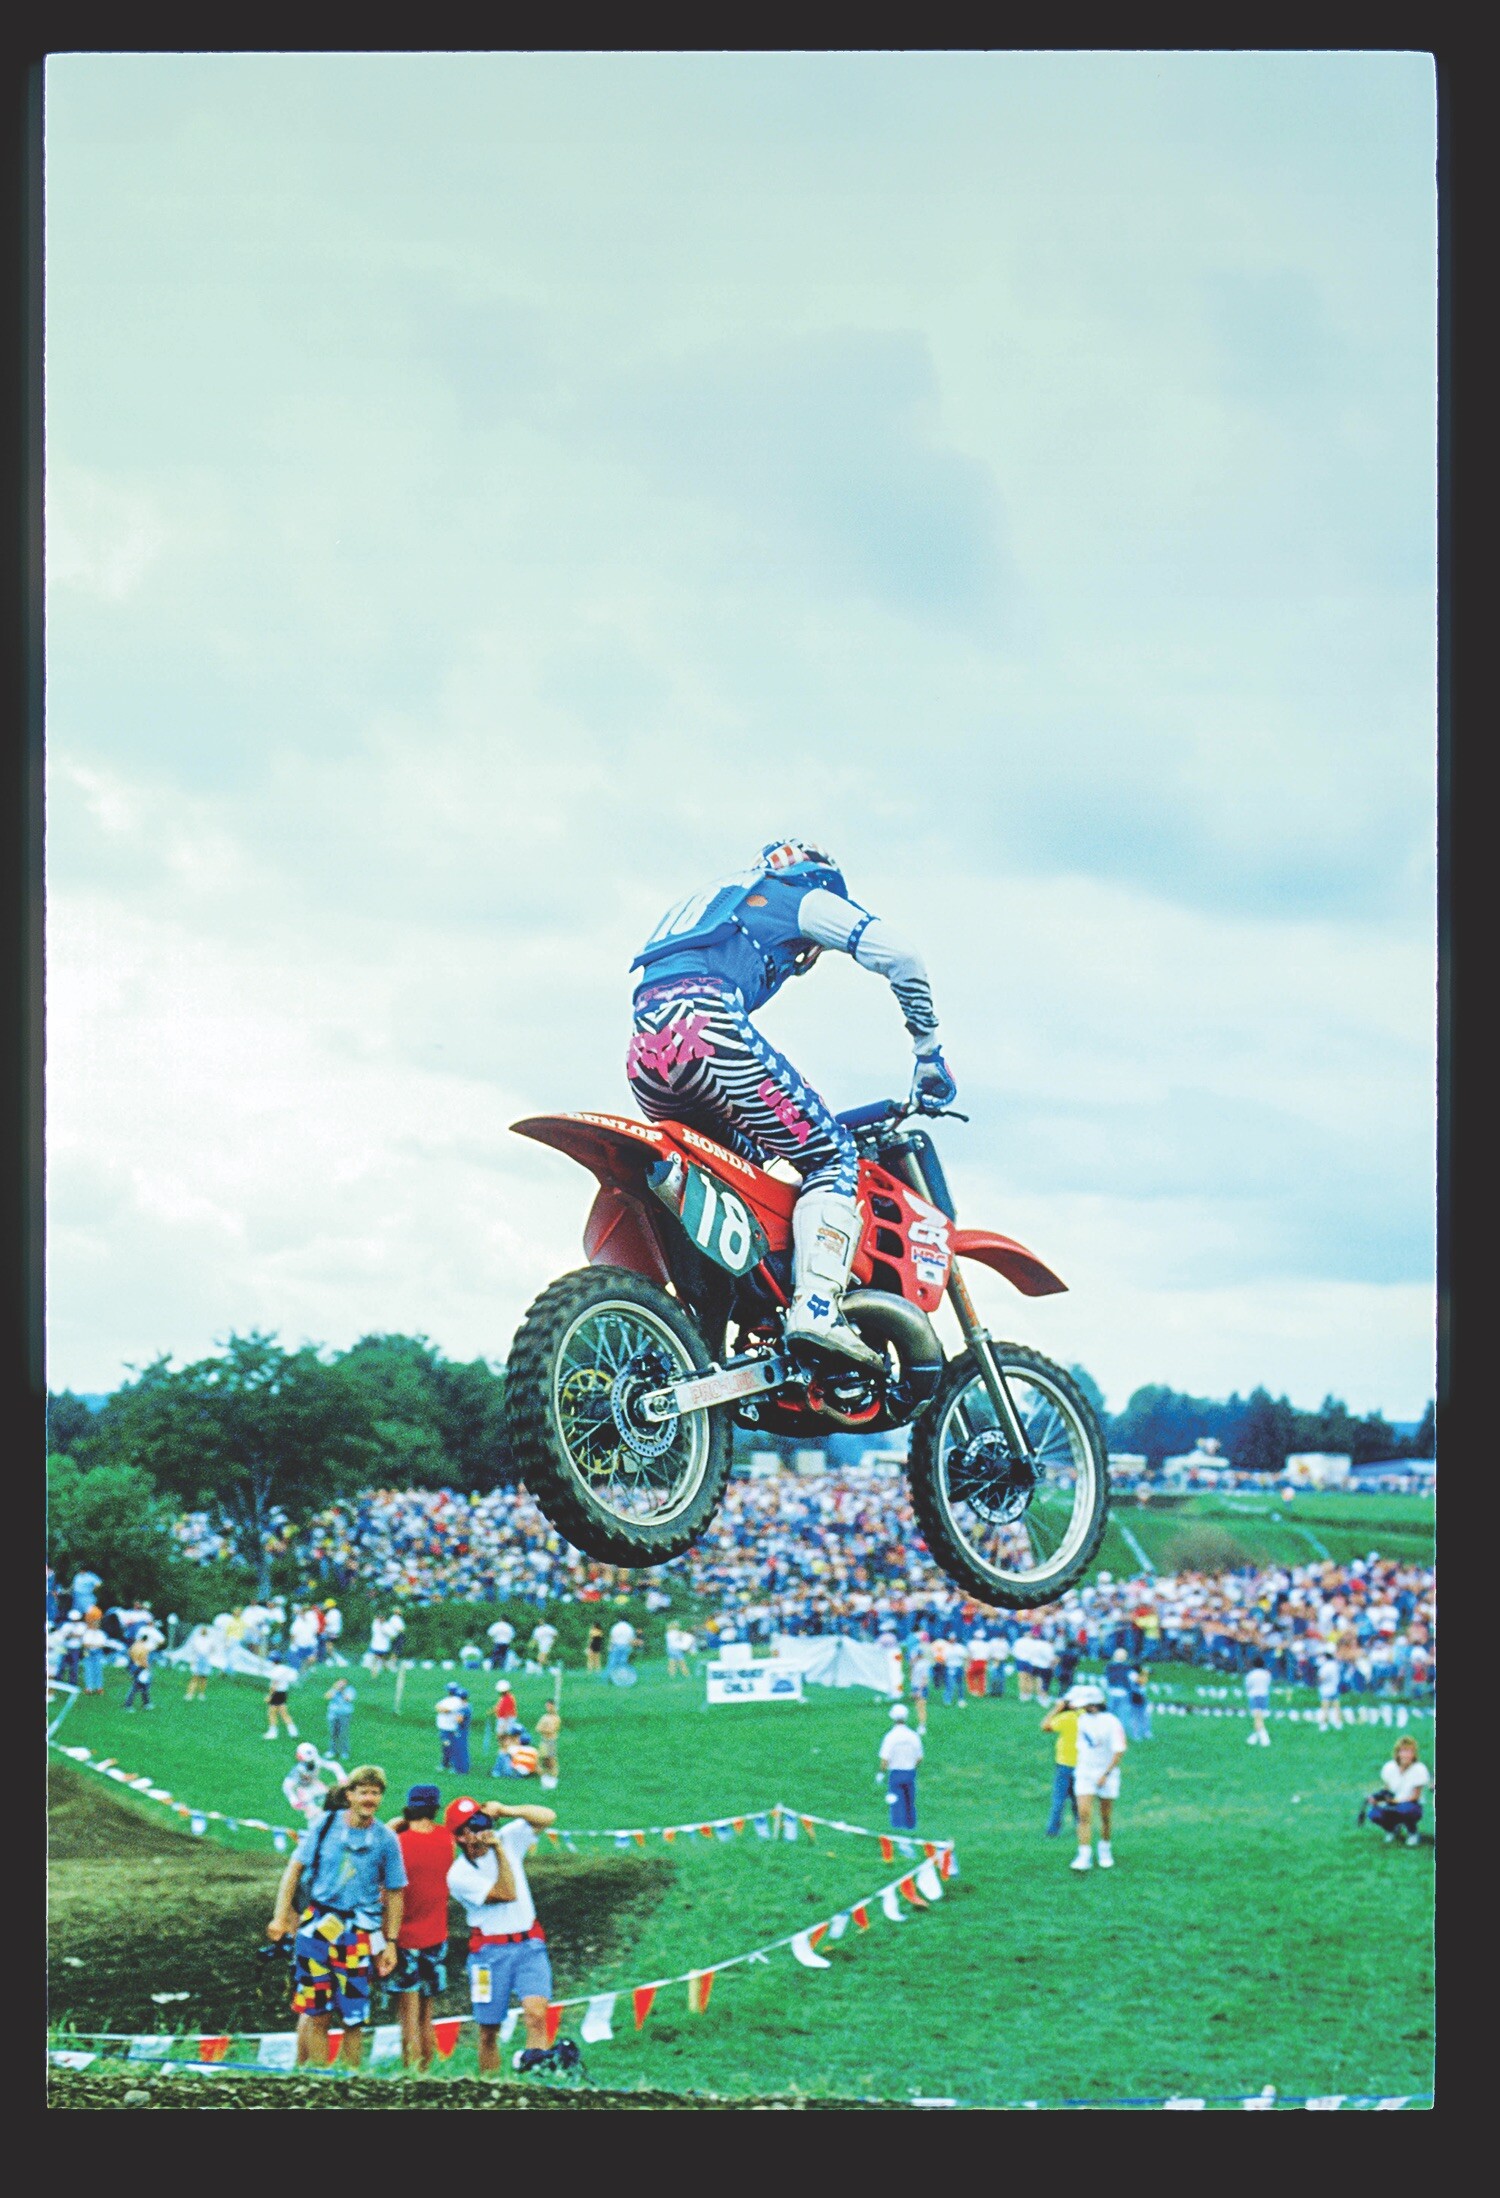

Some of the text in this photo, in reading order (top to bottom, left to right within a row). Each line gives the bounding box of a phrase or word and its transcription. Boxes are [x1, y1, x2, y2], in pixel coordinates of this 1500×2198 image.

[566, 1112, 663, 1142] DUNLOP
[758, 1078, 811, 1145] USA
[682, 1128, 757, 1180] HONDA
[696, 1173, 751, 1270] 18
